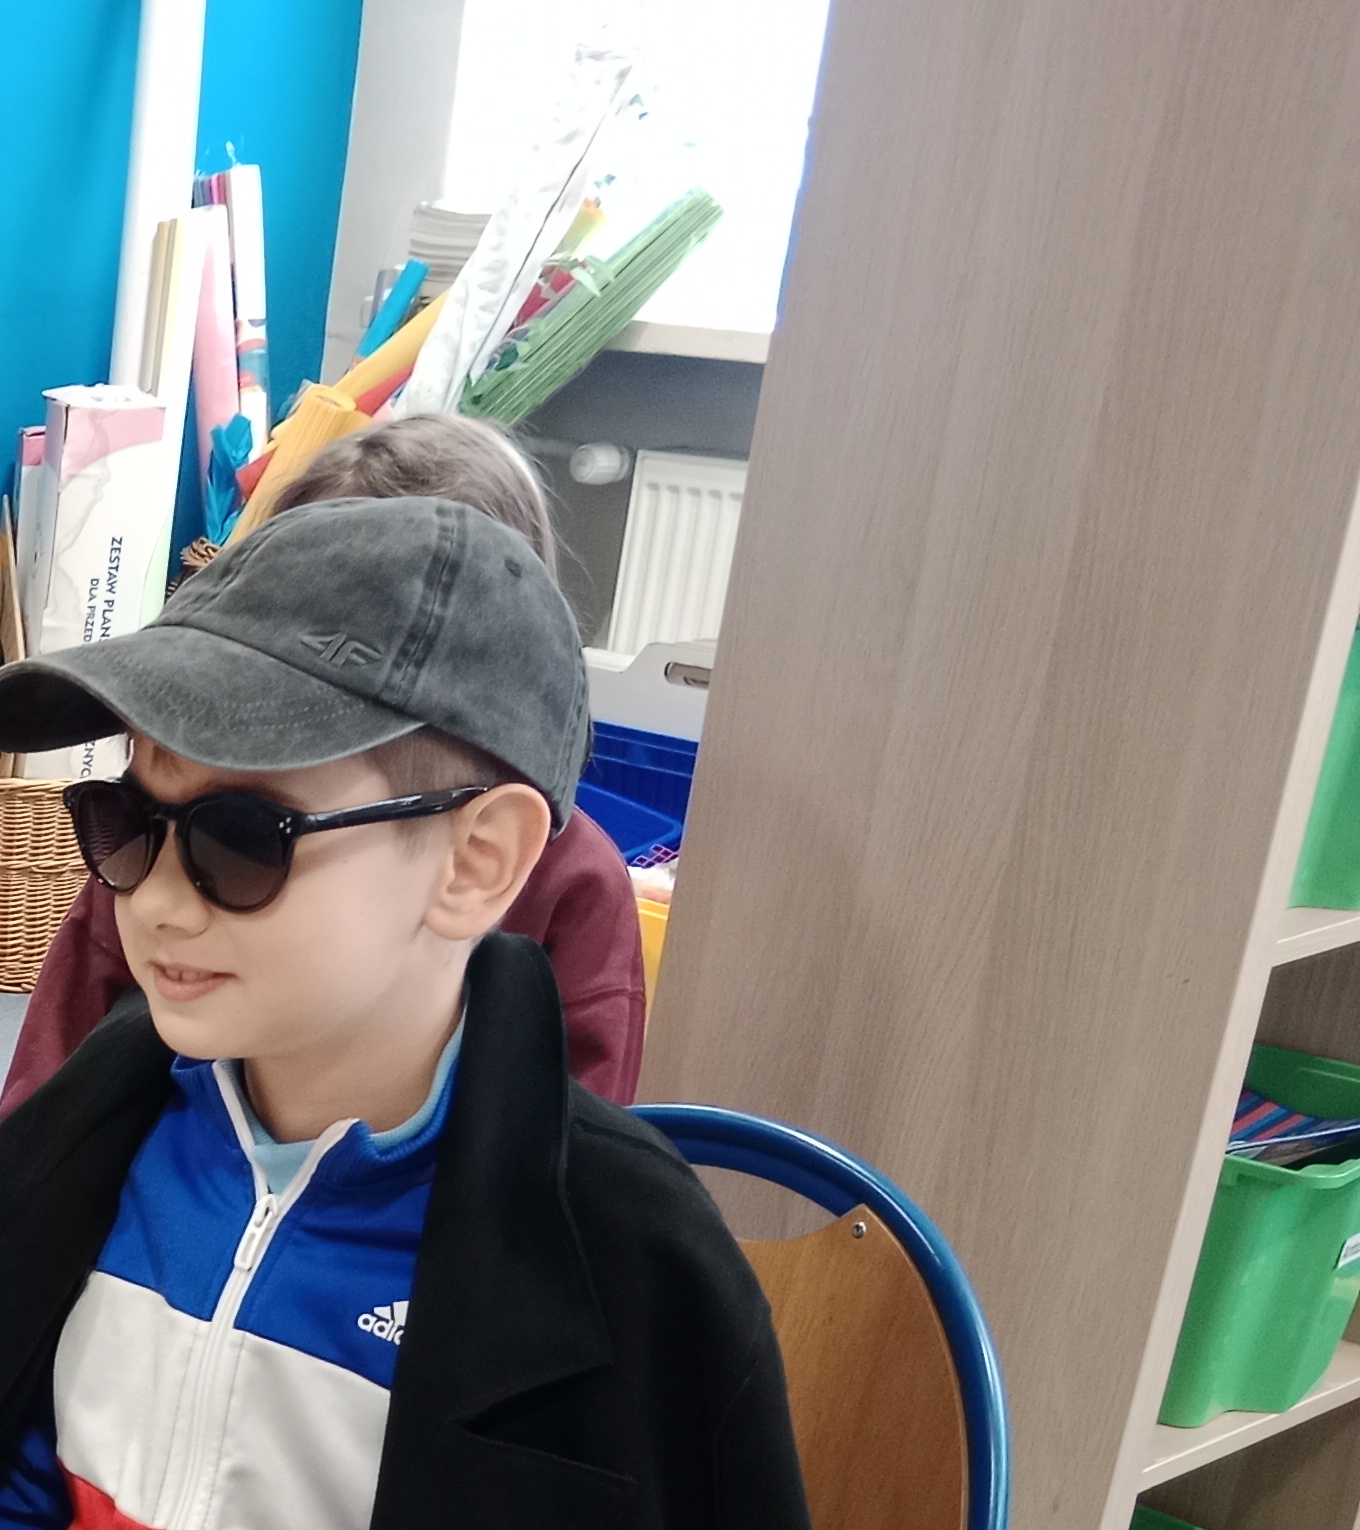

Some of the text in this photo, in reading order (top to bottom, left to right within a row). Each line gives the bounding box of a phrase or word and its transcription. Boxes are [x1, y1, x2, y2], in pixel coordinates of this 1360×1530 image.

[105, 536, 123, 595] ZESTAW
[83, 578, 100, 643] DLA PRZED
[99, 599, 115, 642] PLAN
[299, 632, 383, 667] 4F
